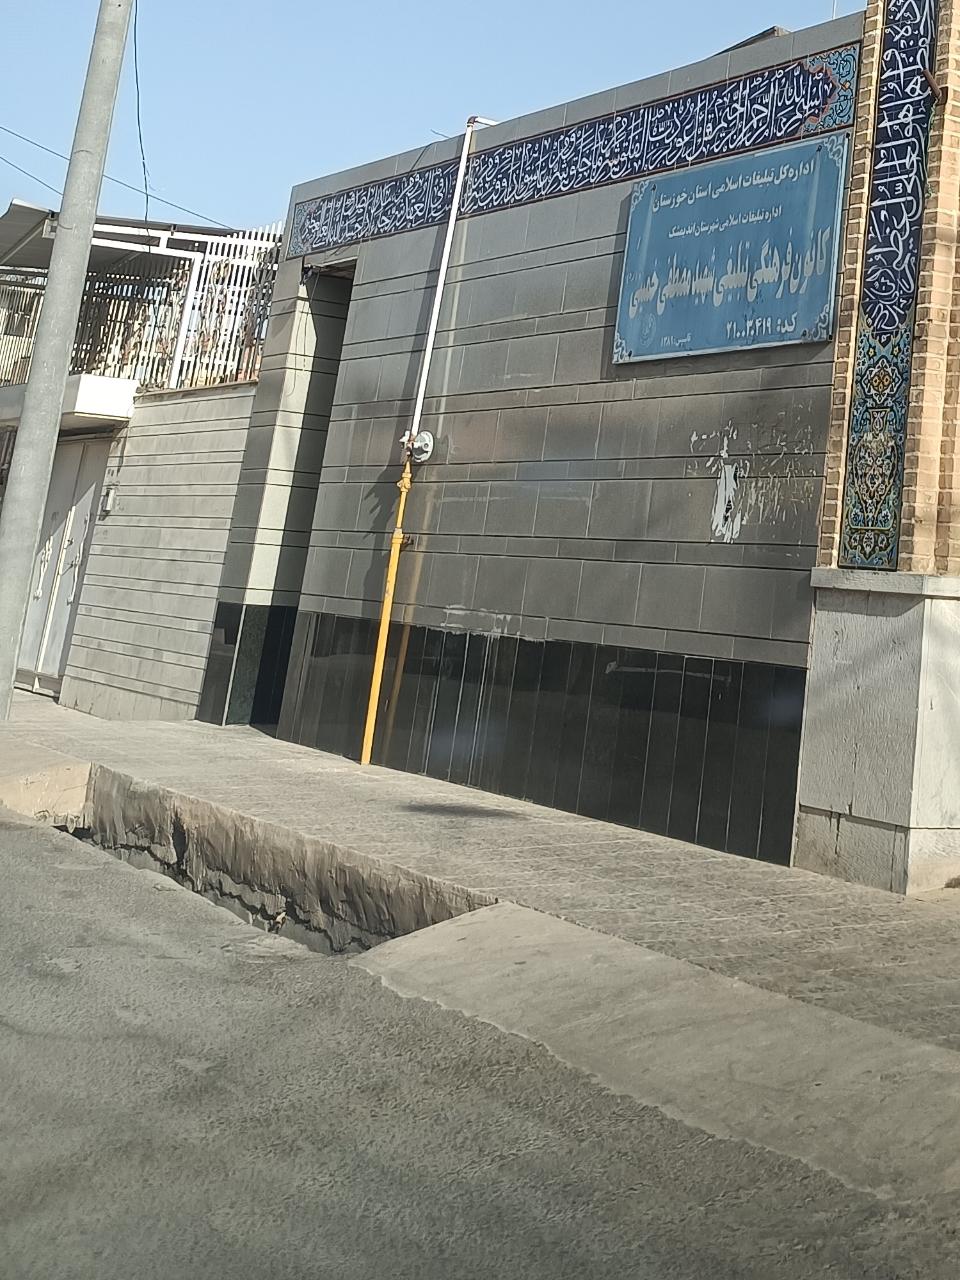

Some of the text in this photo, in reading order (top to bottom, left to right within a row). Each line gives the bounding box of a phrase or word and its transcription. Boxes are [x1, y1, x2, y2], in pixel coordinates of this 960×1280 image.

[652, 159, 814, 213] اداره کل تبلیغات اسلامی استان خوزستان
[766, 205, 782, 221] اداره
[747, 227, 793, 303] فرهنگی
[790, 227, 831, 295] کانون
